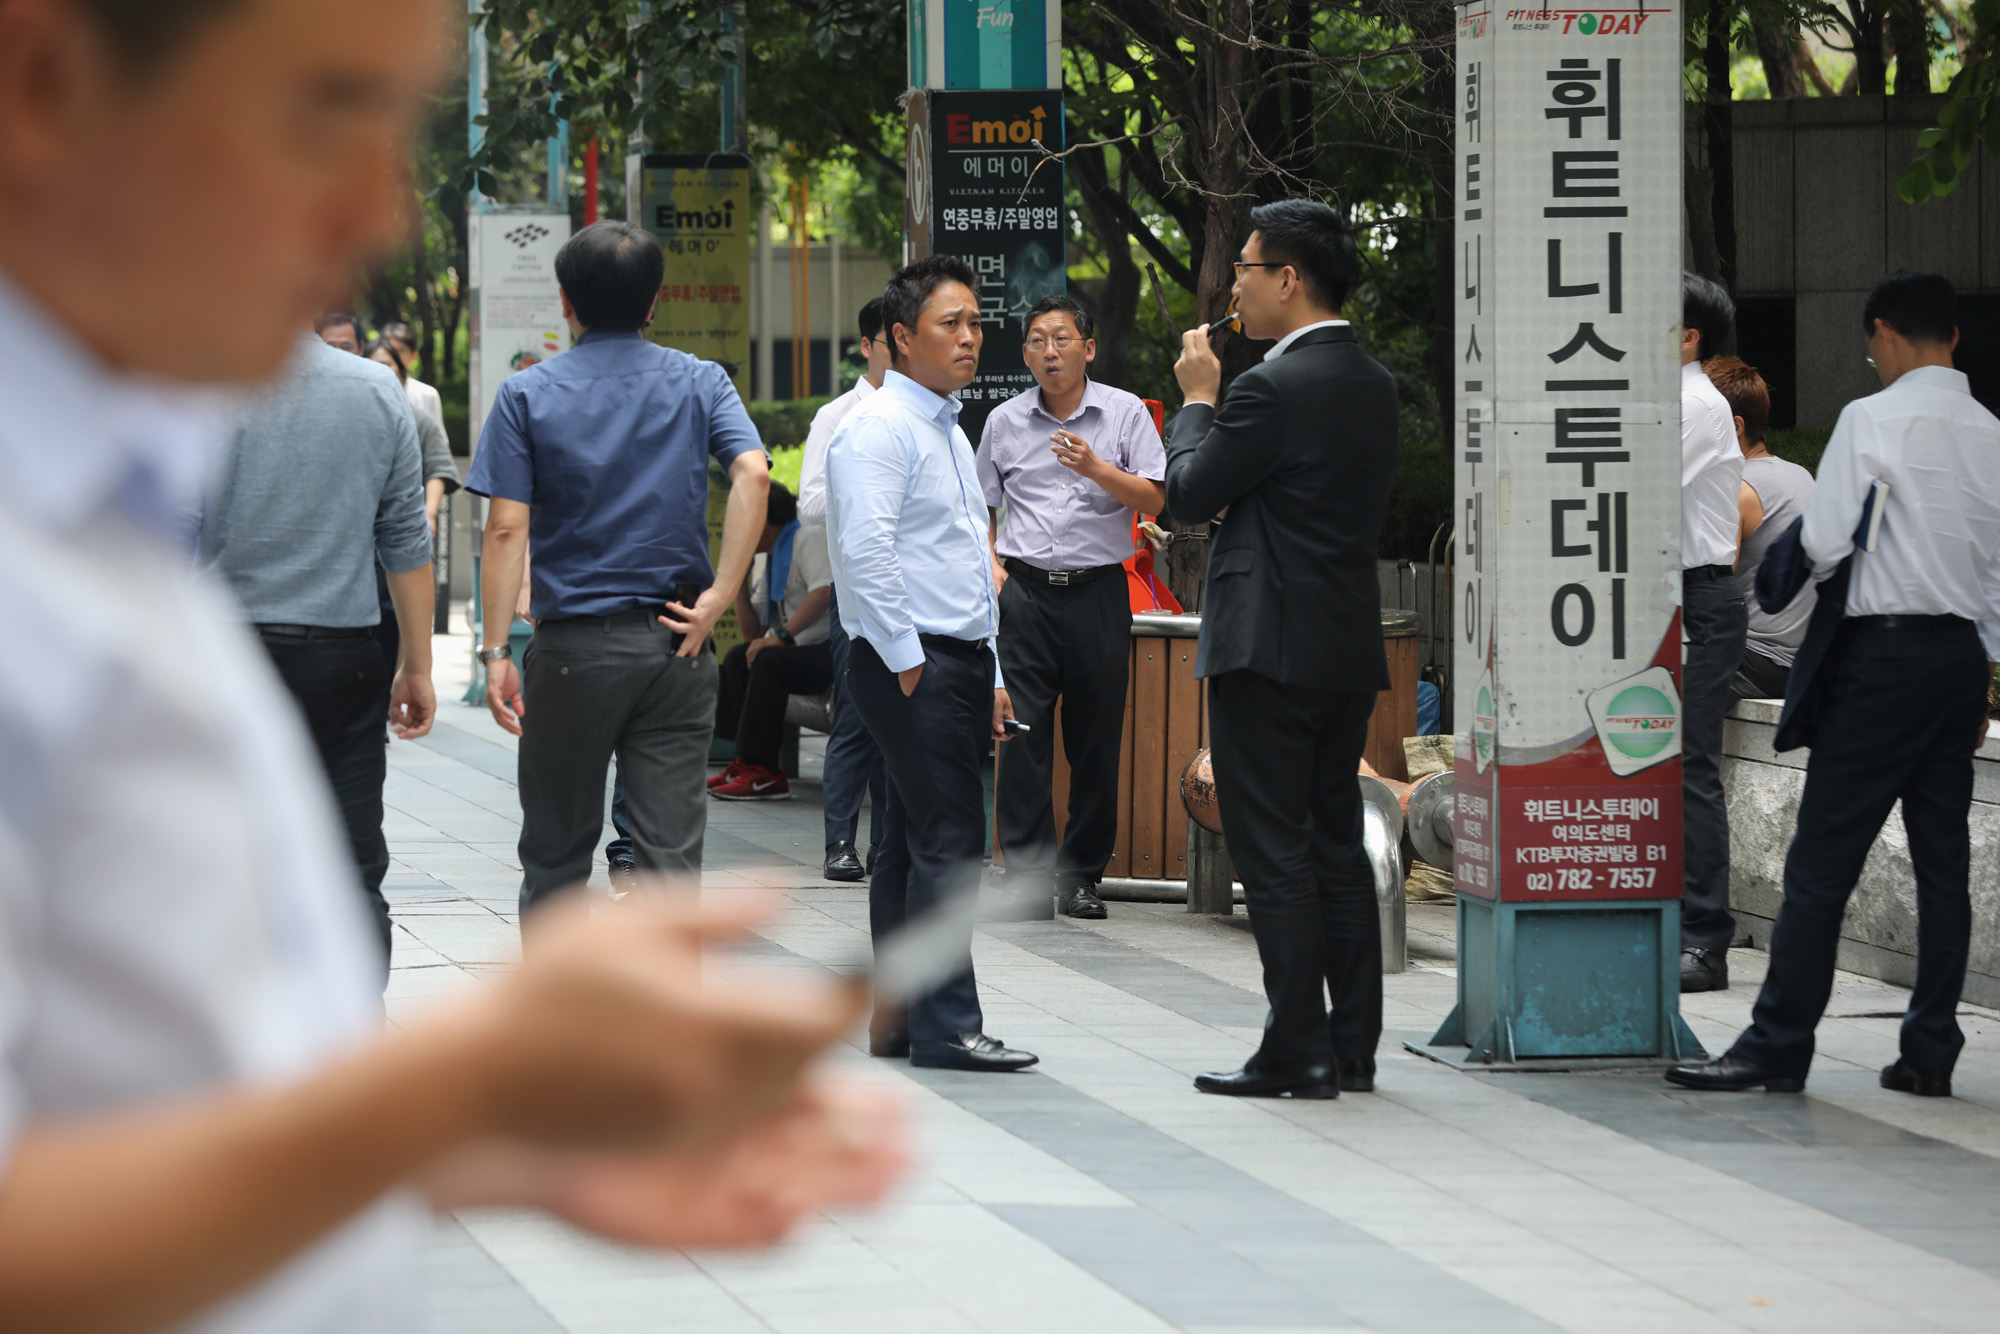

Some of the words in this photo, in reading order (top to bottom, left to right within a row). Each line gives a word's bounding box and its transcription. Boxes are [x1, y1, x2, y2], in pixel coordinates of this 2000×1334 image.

[976, 7, 1014, 28] Fun
[1562, 13, 1649, 35] TODAY
[943, 207, 1058, 231] 연중무휴/주말영업
[657, 284, 741, 303] 중무휴/주말영업
[1465, 61, 1482, 659] 휘트니스투데이
[1544, 58, 1630, 660] 휘트니스투데이
[1632, 719, 1677, 730] TODAY
[1523, 798, 1659, 822] 휘트니스투데이
[1552, 824, 1631, 842] 여의도센터
[1516, 845, 1638, 863] KTB투자증권빌딩
[1646, 845, 1666, 861] B1
[1526, 873, 1553, 891] 02)
